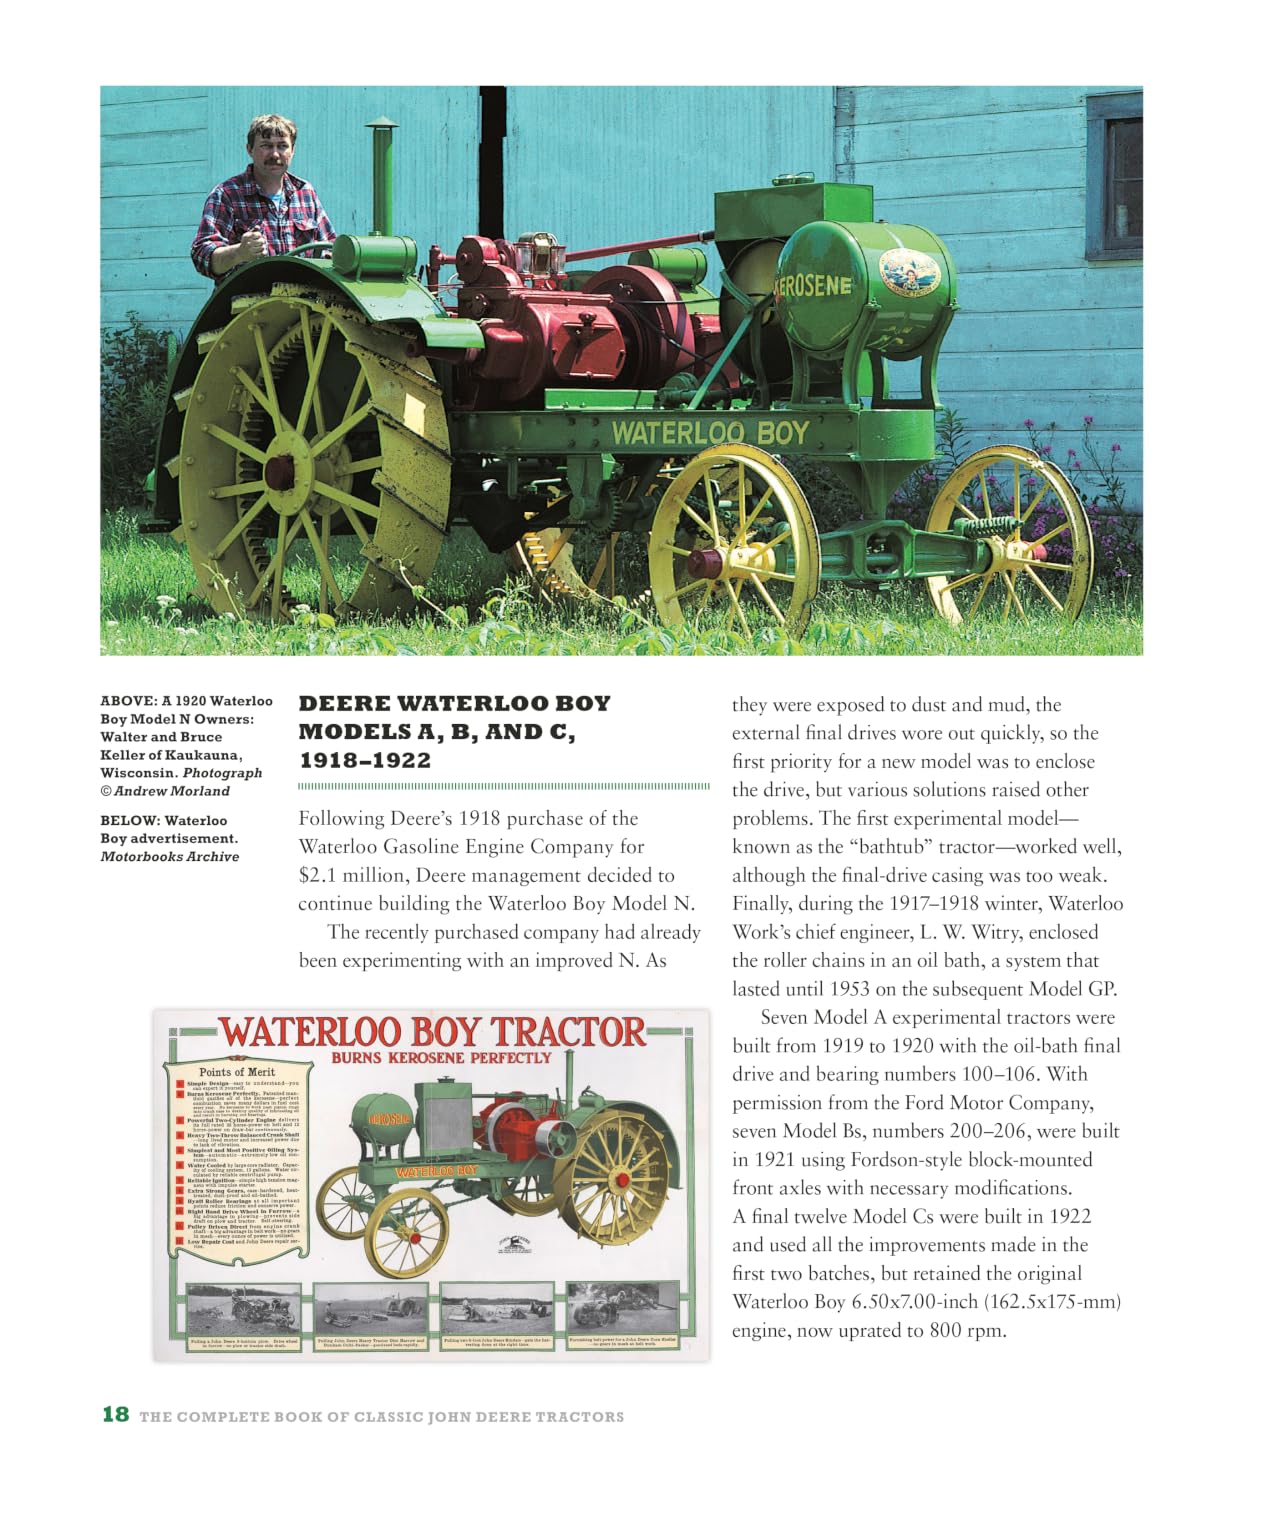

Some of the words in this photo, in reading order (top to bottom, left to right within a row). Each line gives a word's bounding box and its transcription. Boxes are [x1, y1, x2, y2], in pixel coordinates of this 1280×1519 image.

[612, 420, 745, 445] WATERLOO
[757, 420, 810, 445] BOY
[99, 695, 158, 707] ABOVE:
[161, 695, 173, 707] A
[175, 695, 207, 707] 1920
[209, 695, 273, 707] Waterloo
[298, 695, 391, 712] DEERE
[396, 695, 549, 712] WATERLOO
[555, 695, 611, 712] BOY
[100, 713, 128, 728] Boy
[130, 713, 177, 725] Model
[179, 713, 191, 725] N
[194, 713, 254, 725] Owners:
[99, 731, 148, 743] Walter
[150, 731, 178, 743] and
[180, 731, 223, 743] Bruce
[298, 723, 412, 740] MODELS
[417, 723, 444, 745] A,
[451, 723, 479, 745] B,
[485, 723, 543, 740] AND
[549, 723, 575, 745] C,
[100, 749, 146, 761] Keller
[148, 749, 163, 761] of
[164, 749, 243, 763] Kaukauna,
[99, 767, 179, 779] Wisconsin.
[182, 767, 263, 782] Photograph
[169, 785, 231, 797] Morland
[100, 814, 161, 826] BELOW:
[164, 815, 228, 826] Waterloo
[100, 832, 128, 847] Boy
[130, 832, 239, 844] advertisement.
[99, 850, 184, 863] Motorbooks
[185, 850, 240, 862] Archive
[298, 894, 373, 911] continue
[378, 894, 451, 916] building
[455, 894, 483, 911] the
[487, 894, 567, 911] Waterloo
[572, 895, 606, 916] Boy
[611, 894, 667, 911] Model
[673, 895, 695, 911] N.
[217, 1016, 401, 1047] WATERLOO
[411, 1016, 480, 1047] BOY
[490, 1016, 647, 1047] TRACTOR
[331, 1051, 382, 1064] BURNS
[388, 1051, 465, 1064] KEROSENE
[470, 1051, 553, 1064] PERFECTLY
[199, 1067, 231, 1077] Points
[234, 1067, 245, 1077] of
[248, 1067, 276, 1077] Merit
[732, 1094, 823, 1115] permission
[828, 1093, 869, 1111] from
[873, 1093, 900, 1111] the
[905, 1093, 944, 1111] Ford
[949, 1094, 1004, 1111] Motor
[1008, 1094, 1094, 1115] Company,
[395, 1165, 454, 1179] WATERLOO
[457, 1164, 480, 1176] BOY
[732, 1321, 792, 1342] engine,
[796, 1327, 834, 1338] now
[838, 1321, 902, 1343] uprated
[907, 1325, 924, 1338] to
[930, 1321, 962, 1338] 800
[967, 1327, 1007, 1342] rpm.
[103, 1405, 130, 1423] 18
[139, 1411, 172, 1423] THE
[176, 1411, 270, 1423] COMPLETE
[274, 1411, 323, 1423] BOOK
[327, 1411, 350, 1423] OF
[354, 1411, 424, 1423] CLASSIC
[427, 1411, 472, 1426] JOHN
[475, 1411, 532, 1423] DEERE
[535, 1411, 624, 1423] TRACTORS
